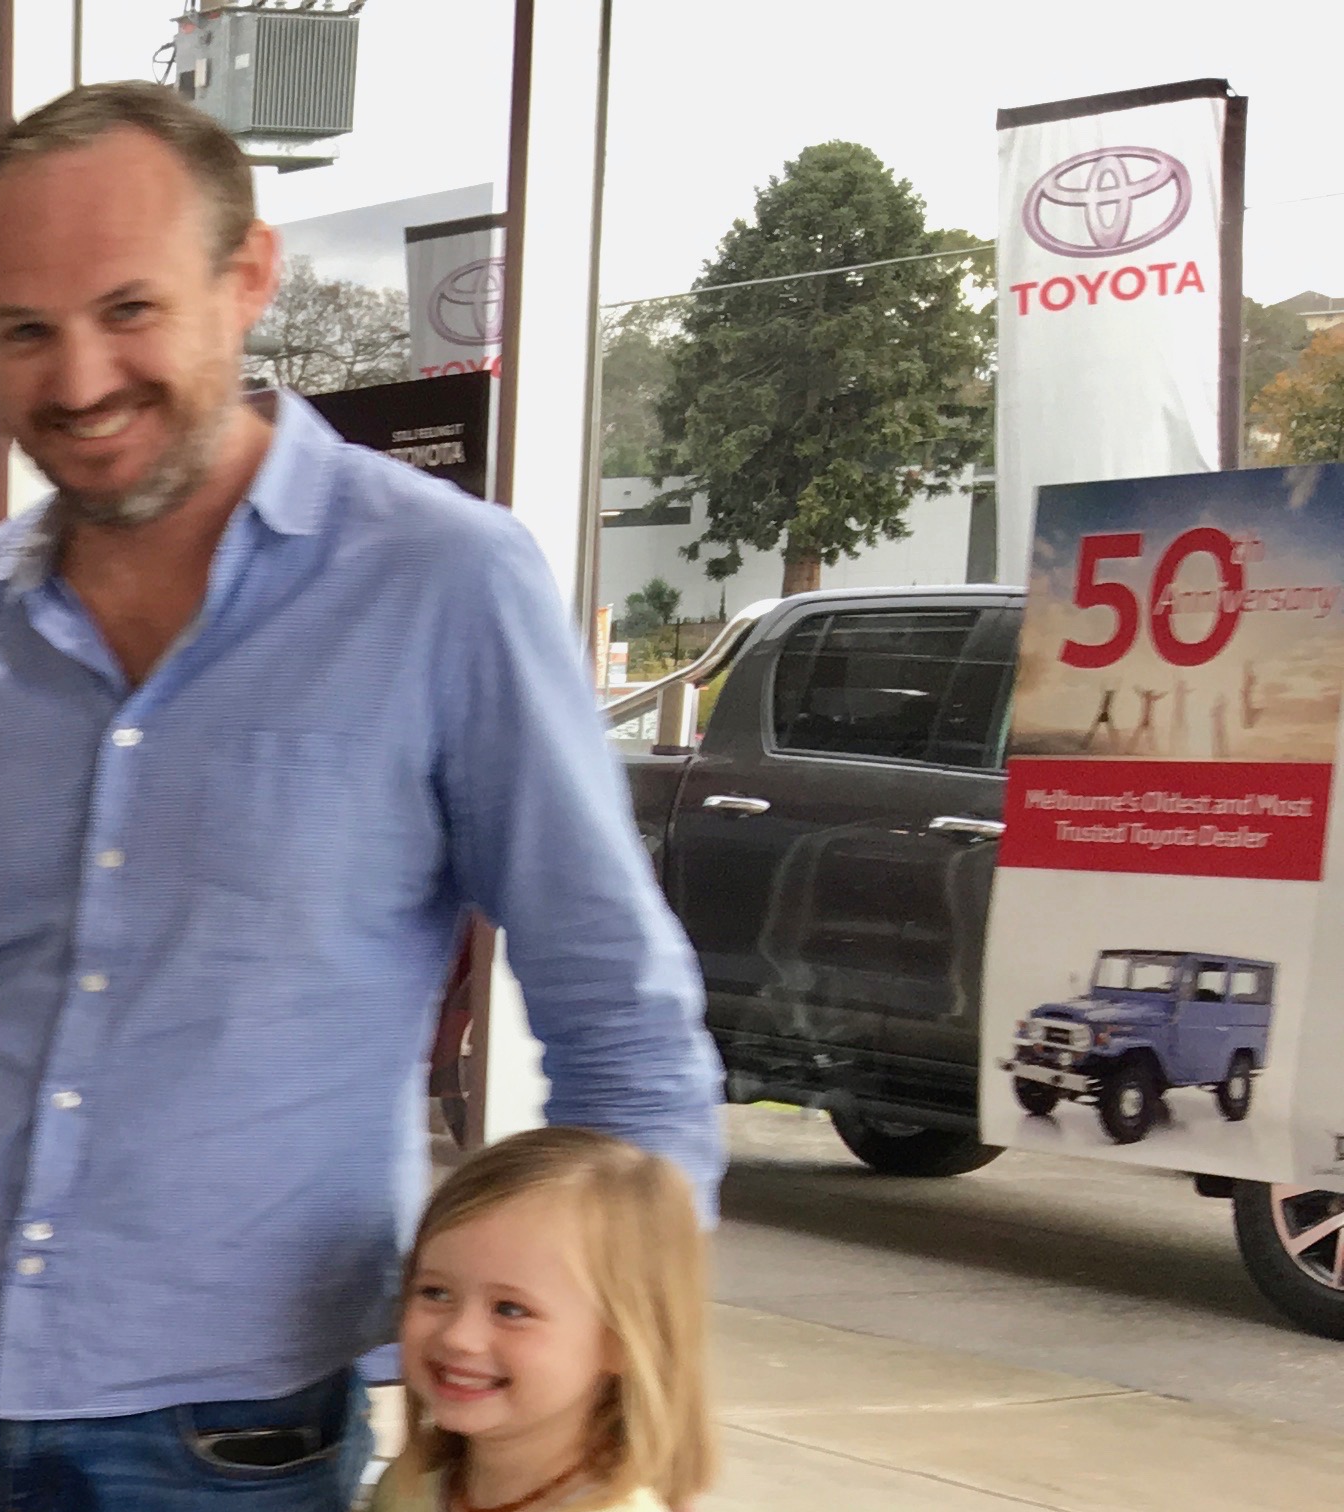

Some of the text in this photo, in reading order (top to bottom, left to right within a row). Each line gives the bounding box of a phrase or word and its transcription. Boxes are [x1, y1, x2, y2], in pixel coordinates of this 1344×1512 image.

[1009, 261, 1205, 316] TOYOTA
[1058, 527, 1249, 670] 50
[1024, 788, 1313, 817] Melbourne's Oldest and Most
[1055, 820, 1273, 850] Trusted Toyota Dealer
